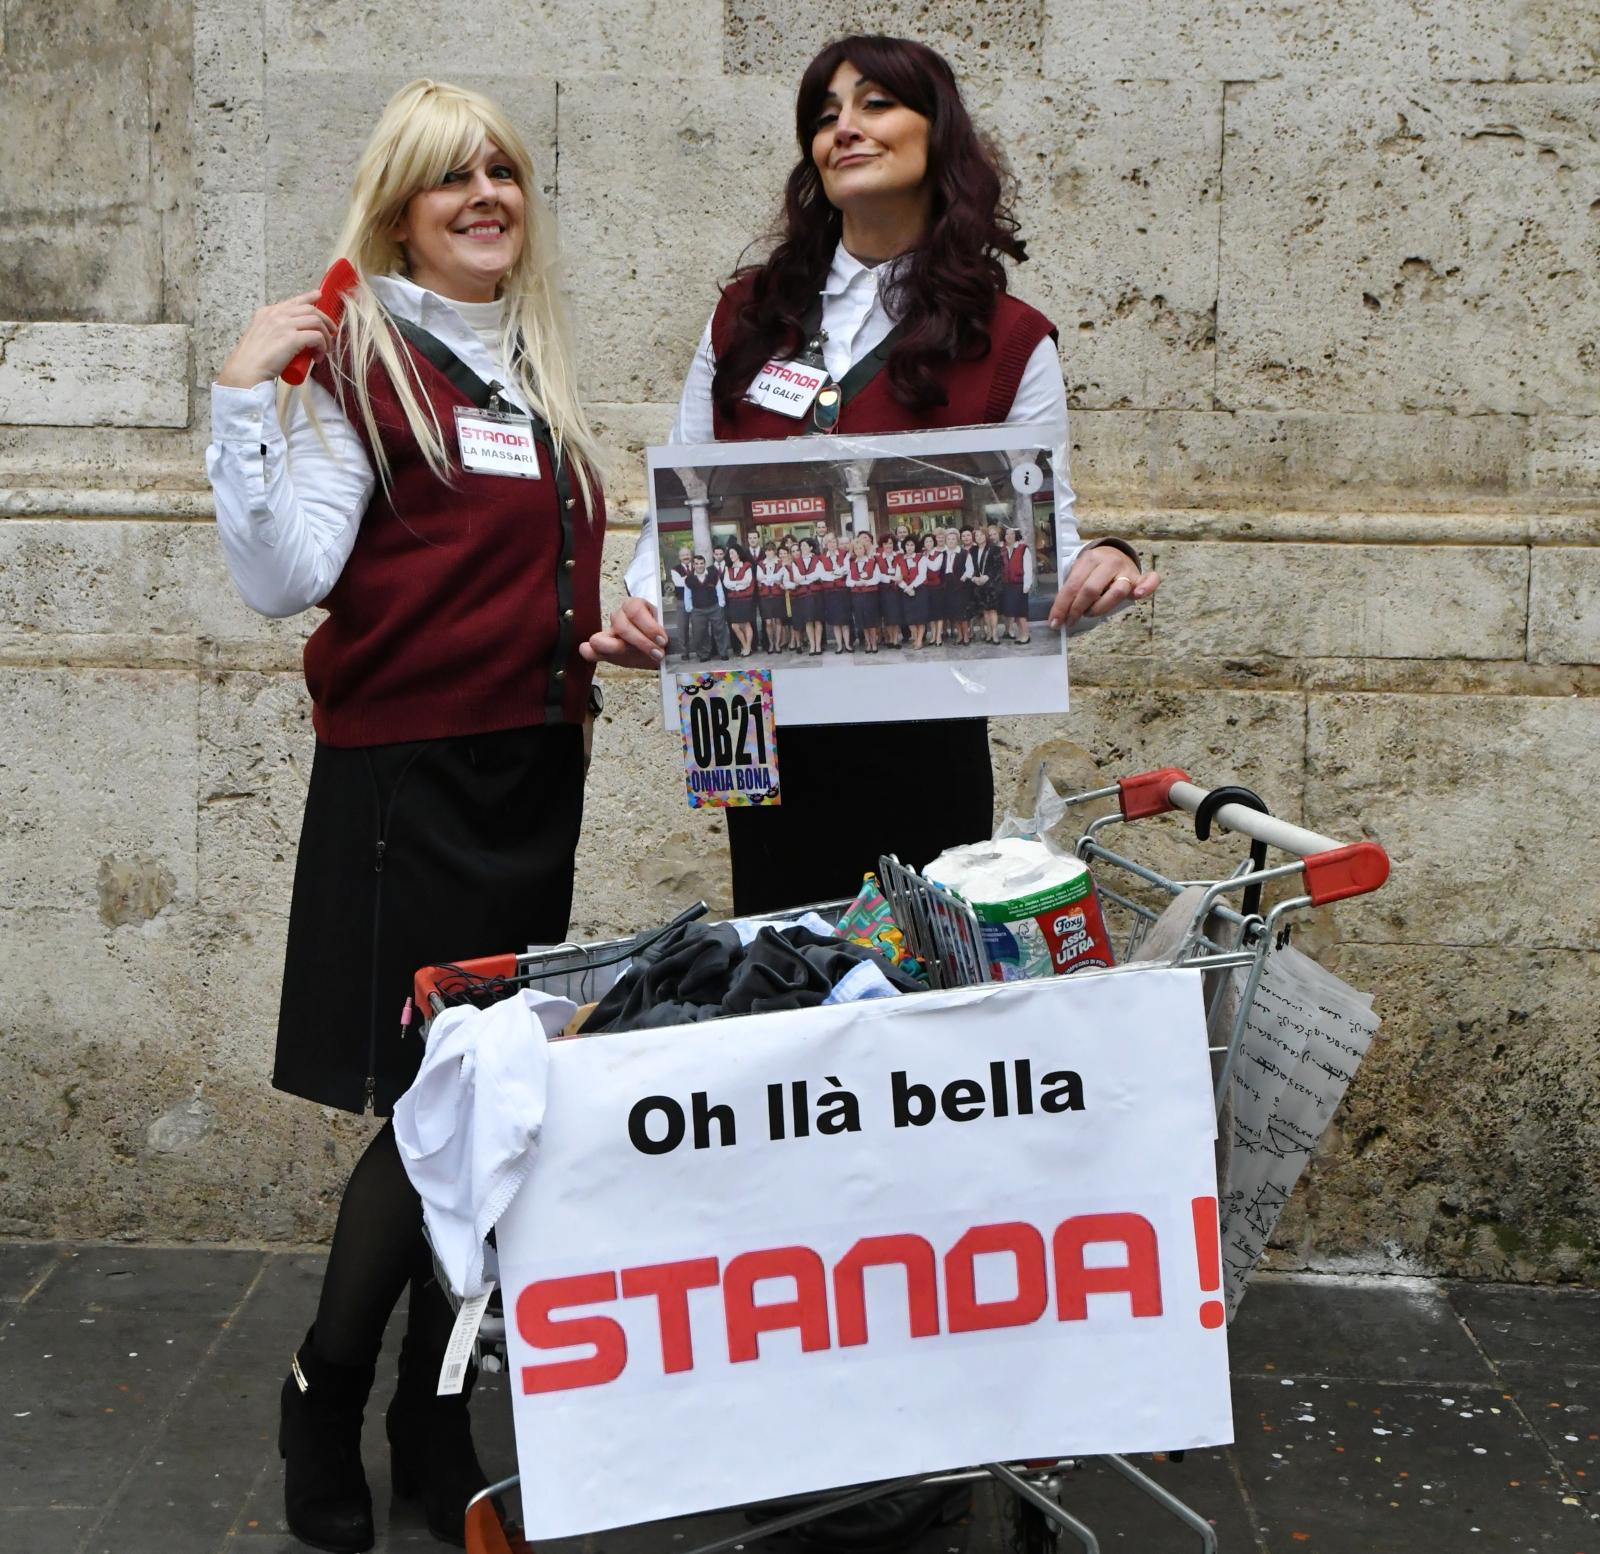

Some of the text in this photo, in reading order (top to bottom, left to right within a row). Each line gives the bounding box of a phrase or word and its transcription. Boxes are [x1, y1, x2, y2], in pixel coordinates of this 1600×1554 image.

[758, 381, 771, 392] LA
[763, 363, 820, 391] STANDA
[461, 427, 529, 447] STANDA
[463, 446, 533, 463] LA MASSARI
[888, 485, 962, 505] STANDA
[752, 498, 825, 515] STANDA
[690, 694, 767, 769] OB21
[691, 767, 771, 793] OMNIA BONA
[1055, 915, 1083, 933] Foxy
[1061, 929, 1087, 950] ASSO
[1056, 936, 1095, 965] ULTRA
[628, 1059, 1085, 1155] Oh llà bella
[516, 1213, 1161, 1394] STANDA
